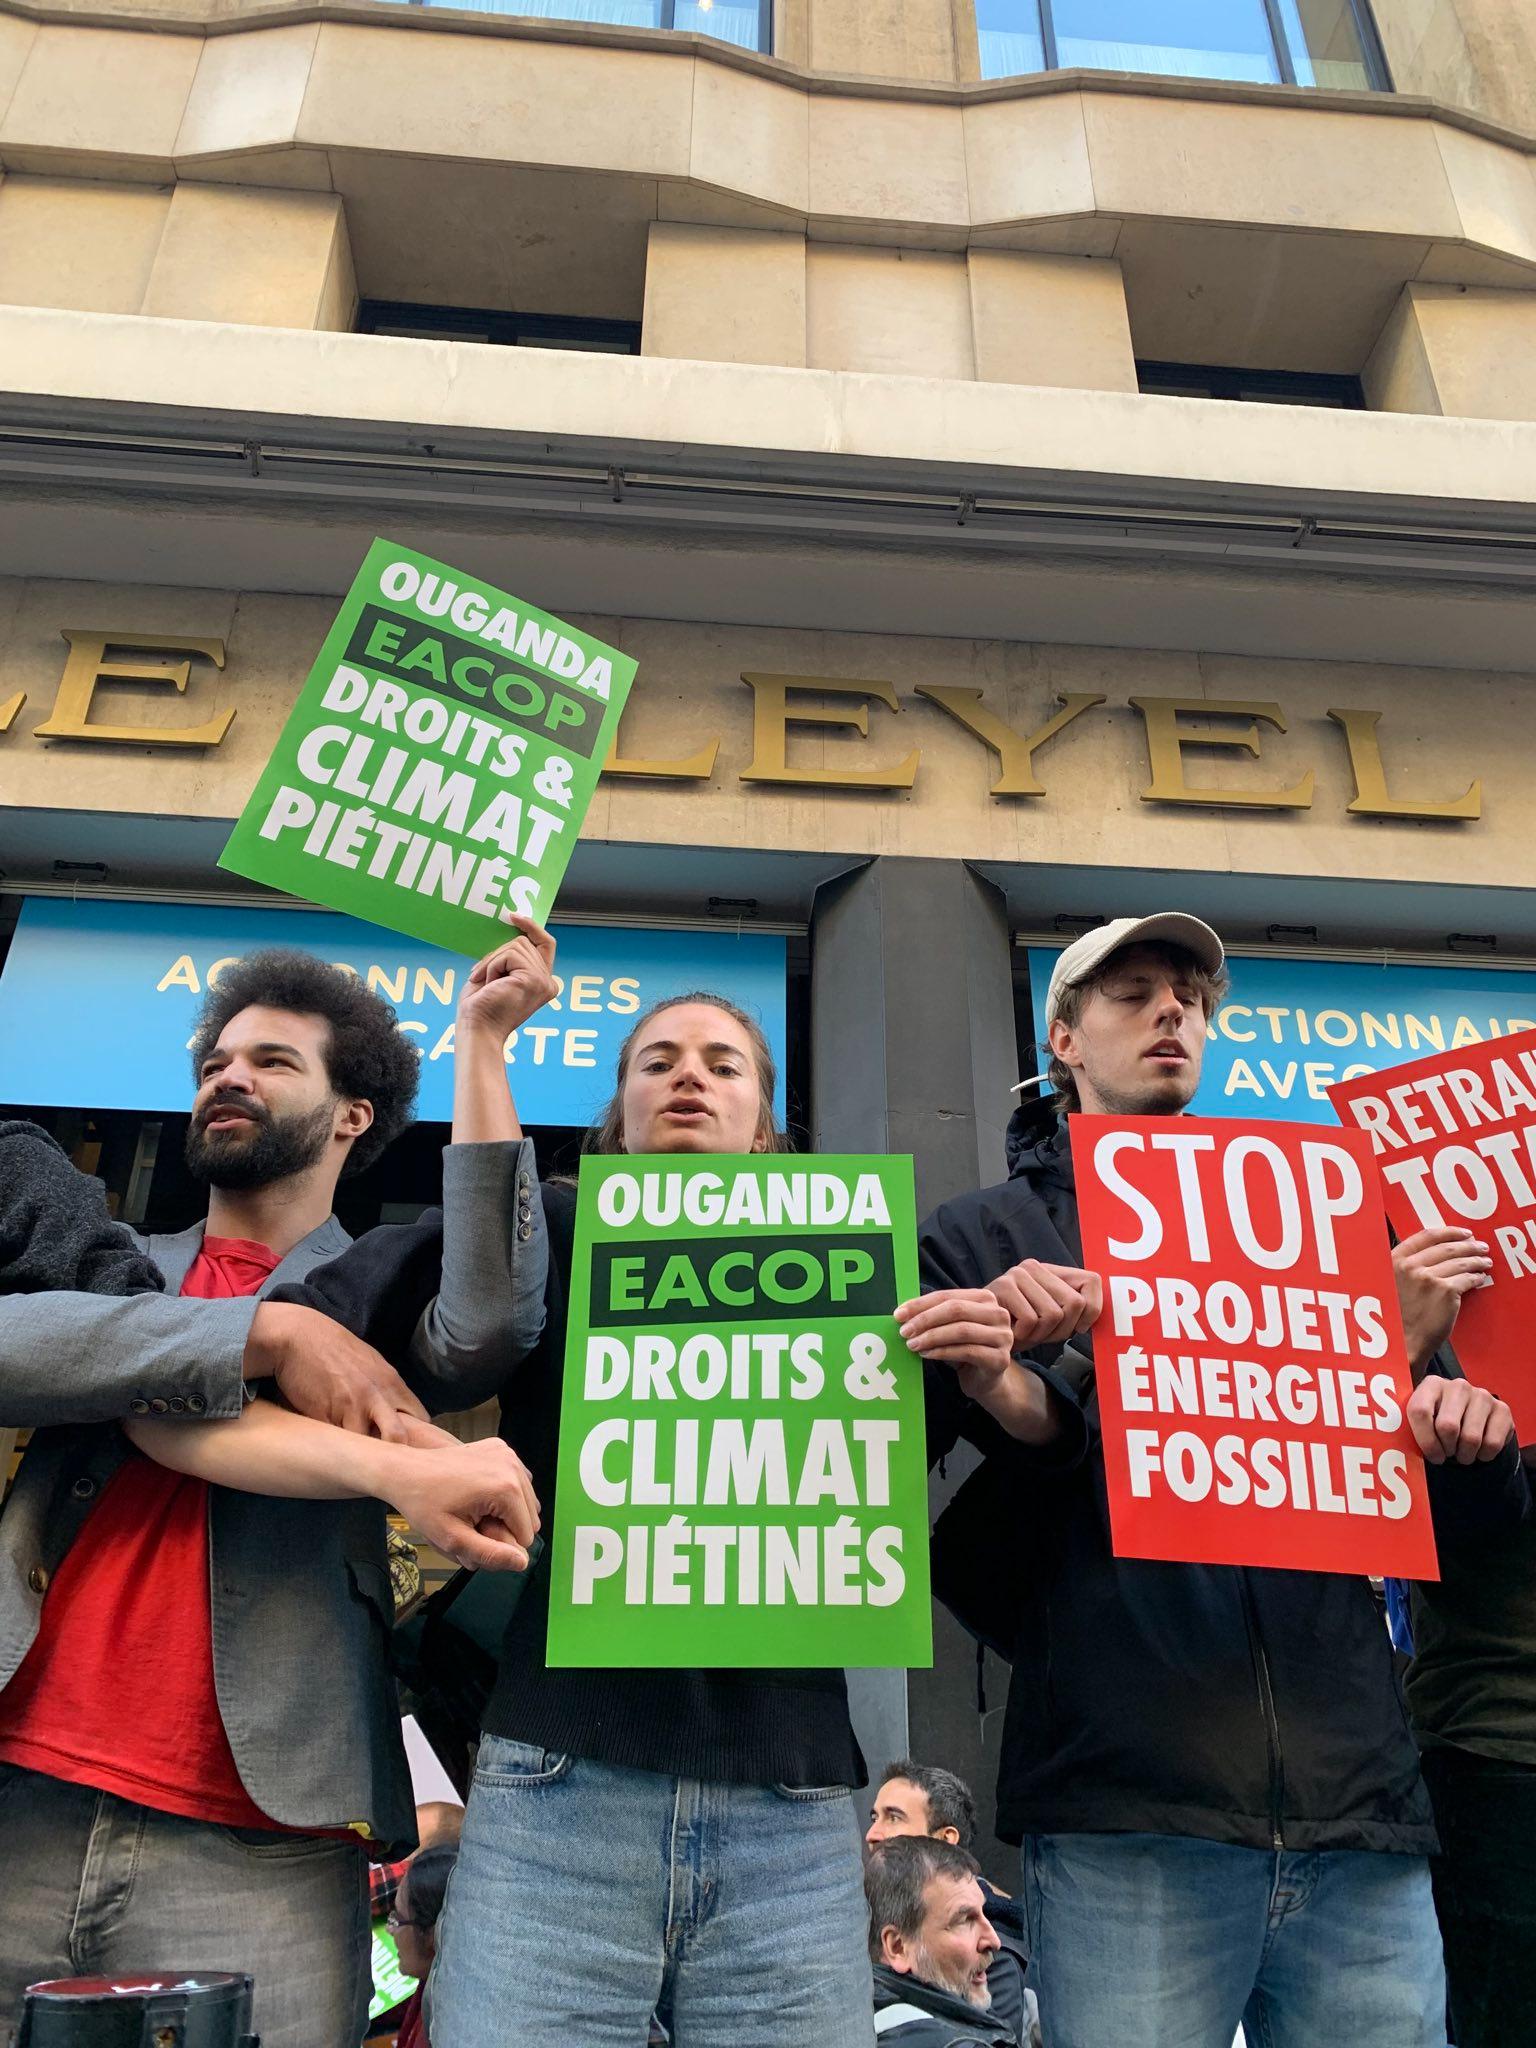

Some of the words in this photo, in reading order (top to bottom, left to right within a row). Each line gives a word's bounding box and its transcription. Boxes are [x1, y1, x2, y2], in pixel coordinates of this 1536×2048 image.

[363, 619, 586, 731] EACOP
[379, 562, 612, 700] OUGANDA
[0, 629, 237, 746] E
[320, 664, 528, 778] DROITS
[533, 756, 574, 809] &
[297, 724, 564, 868] CLIMAT
[258, 785, 541, 926] PIÉTINÉS
[597, 1172, 892, 1228] OUGANDA
[1093, 1131, 1364, 1275] STOP
[1383, 1126, 1536, 1231] TOT
[609, 1249, 875, 1312] EACOP
[1109, 1276, 1388, 1359] PROJETS
[584, 1333, 825, 1401] DROITS
[844, 1332, 900, 1400] &
[1117, 1345, 1402, 1433] ÉNERGIES
[578, 1418, 900, 1507] CLIMAT
[1125, 1429, 1412, 1520] FOSSILES
[571, 1513, 906, 1607] PIÉTINÉS
